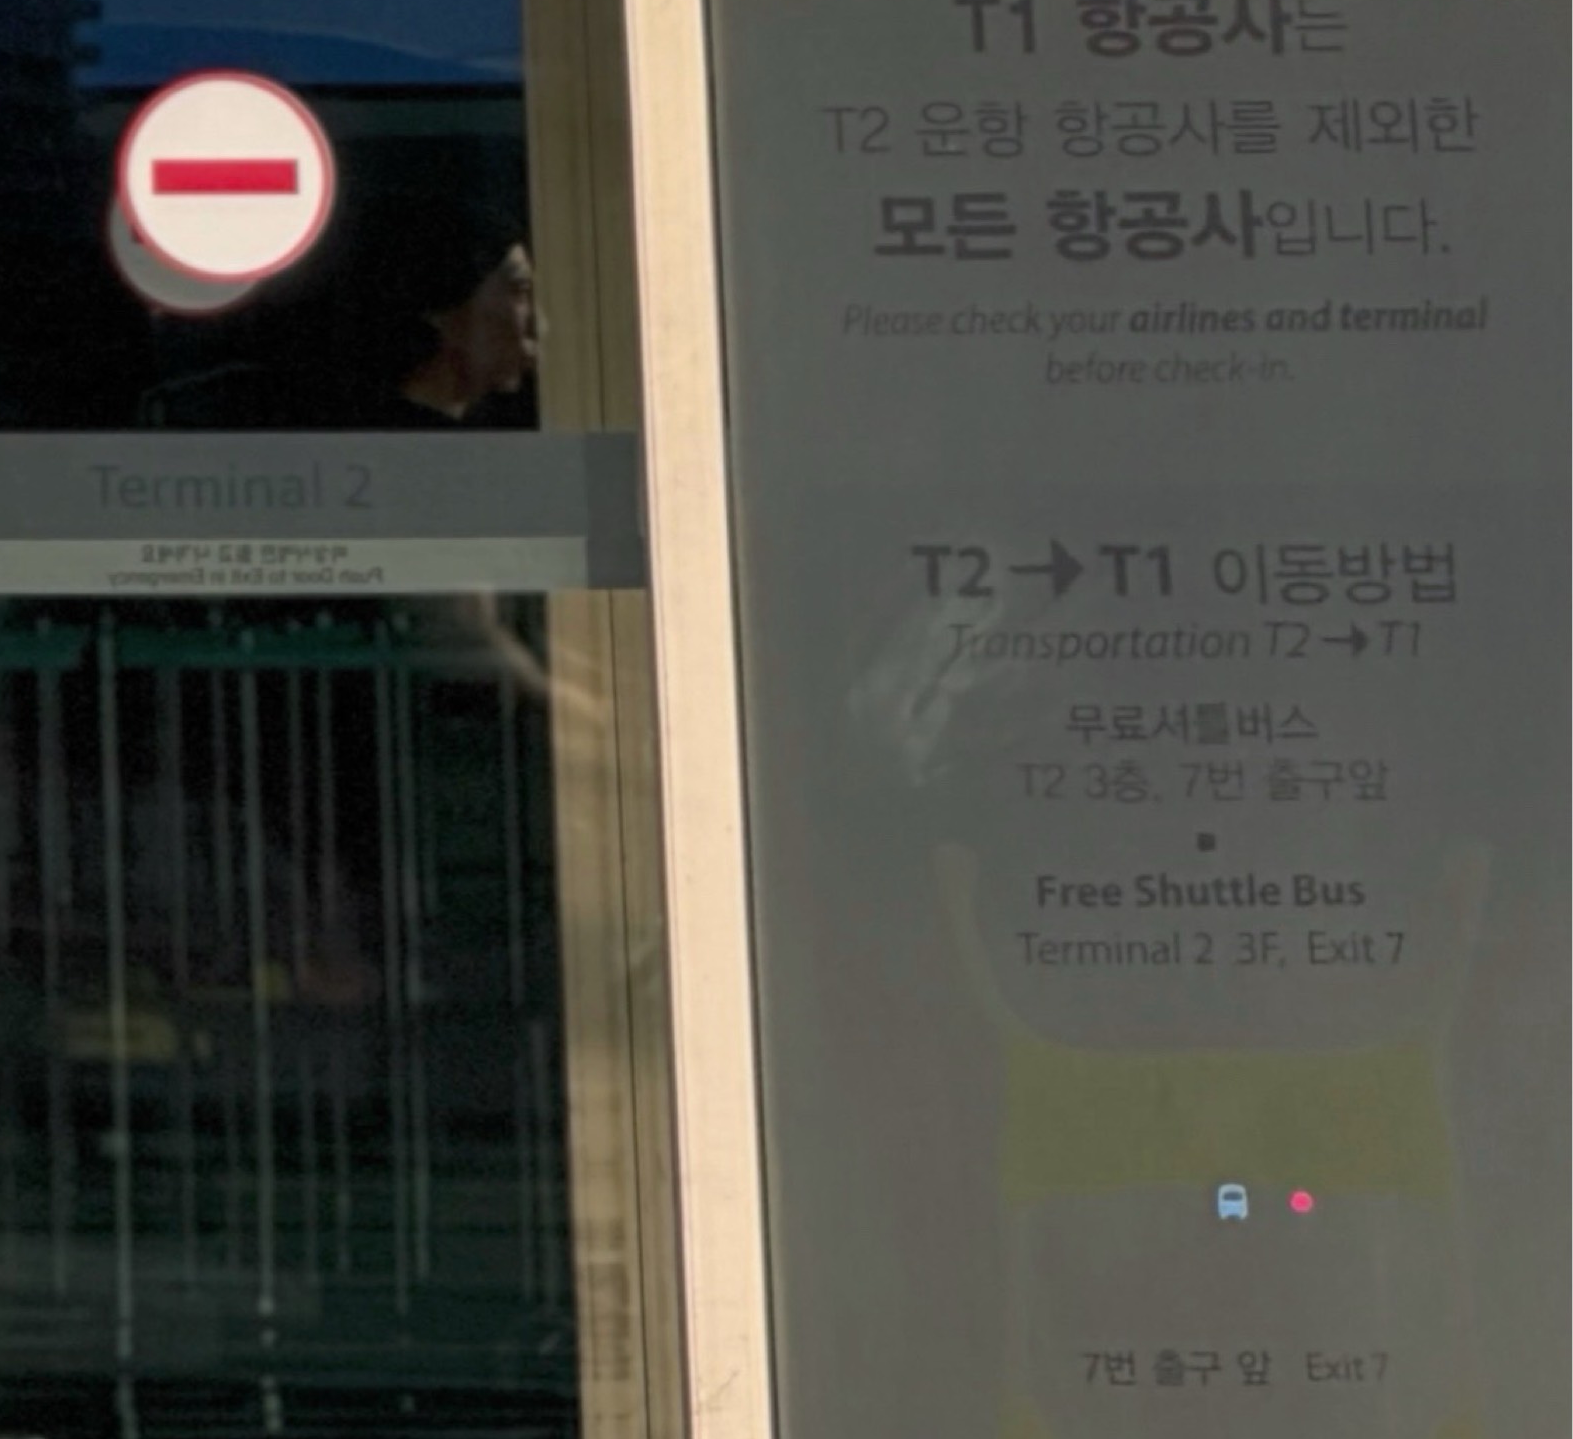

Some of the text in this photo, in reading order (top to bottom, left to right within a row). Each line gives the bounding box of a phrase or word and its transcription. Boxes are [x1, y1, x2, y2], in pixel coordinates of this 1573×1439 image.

[821, 95, 1480, 159] T2 운항 항공사를 제외한
[873, 189, 1453, 261] 모든 항공사입니다.
[841, 298, 1490, 345] Please check your airlines and terminal
[1043, 351, 1146, 386] before
[89, 461, 373, 510] Terminal 2
[911, 541, 1458, 607] T2 T1 이동방법
[948, 620, 1423, 669] Transportation T2 T1
[1064, 701, 1320, 746] 무료셔틀버스
[1016, 763, 1066, 800] T2
[1179, 759, 1244, 803] 7번
[1036, 872, 1367, 908] Free Shuttle Bus
[1016, 930, 1182, 965] Terminal
[1193, 931, 1214, 965] 2
[1307, 930, 1376, 965] Exit
[1385, 931, 1405, 964] 7
[1082, 1349, 1137, 1387] 7번
[1306, 1350, 1364, 1383] Exit
[1370, 1351, 1389, 1383] 7
